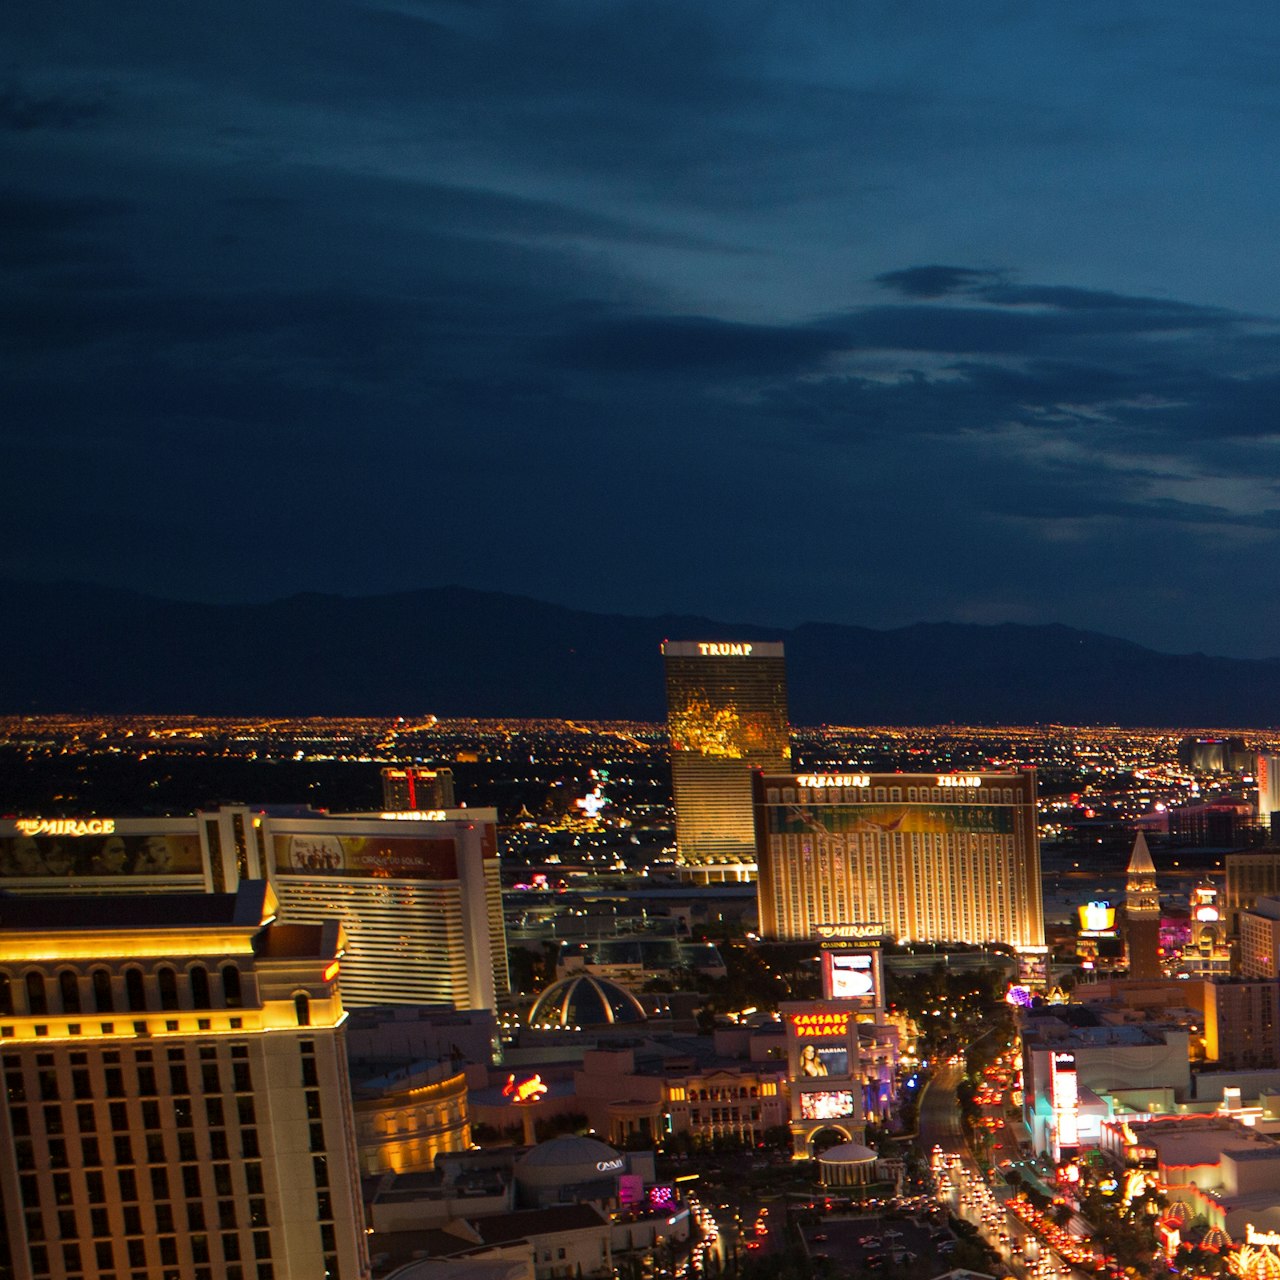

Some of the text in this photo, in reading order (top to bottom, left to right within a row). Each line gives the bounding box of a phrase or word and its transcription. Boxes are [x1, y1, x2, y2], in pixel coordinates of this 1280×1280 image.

[698, 643, 753, 656] TRUMP
[796, 776, 982, 788] TREASURE ISLAND
[24, 819, 115, 836] MIRAGE
[823, 926, 882, 938] MIRAGE
[793, 1013, 849, 1025] CAESARS
[796, 1024, 847, 1036] PALACE
